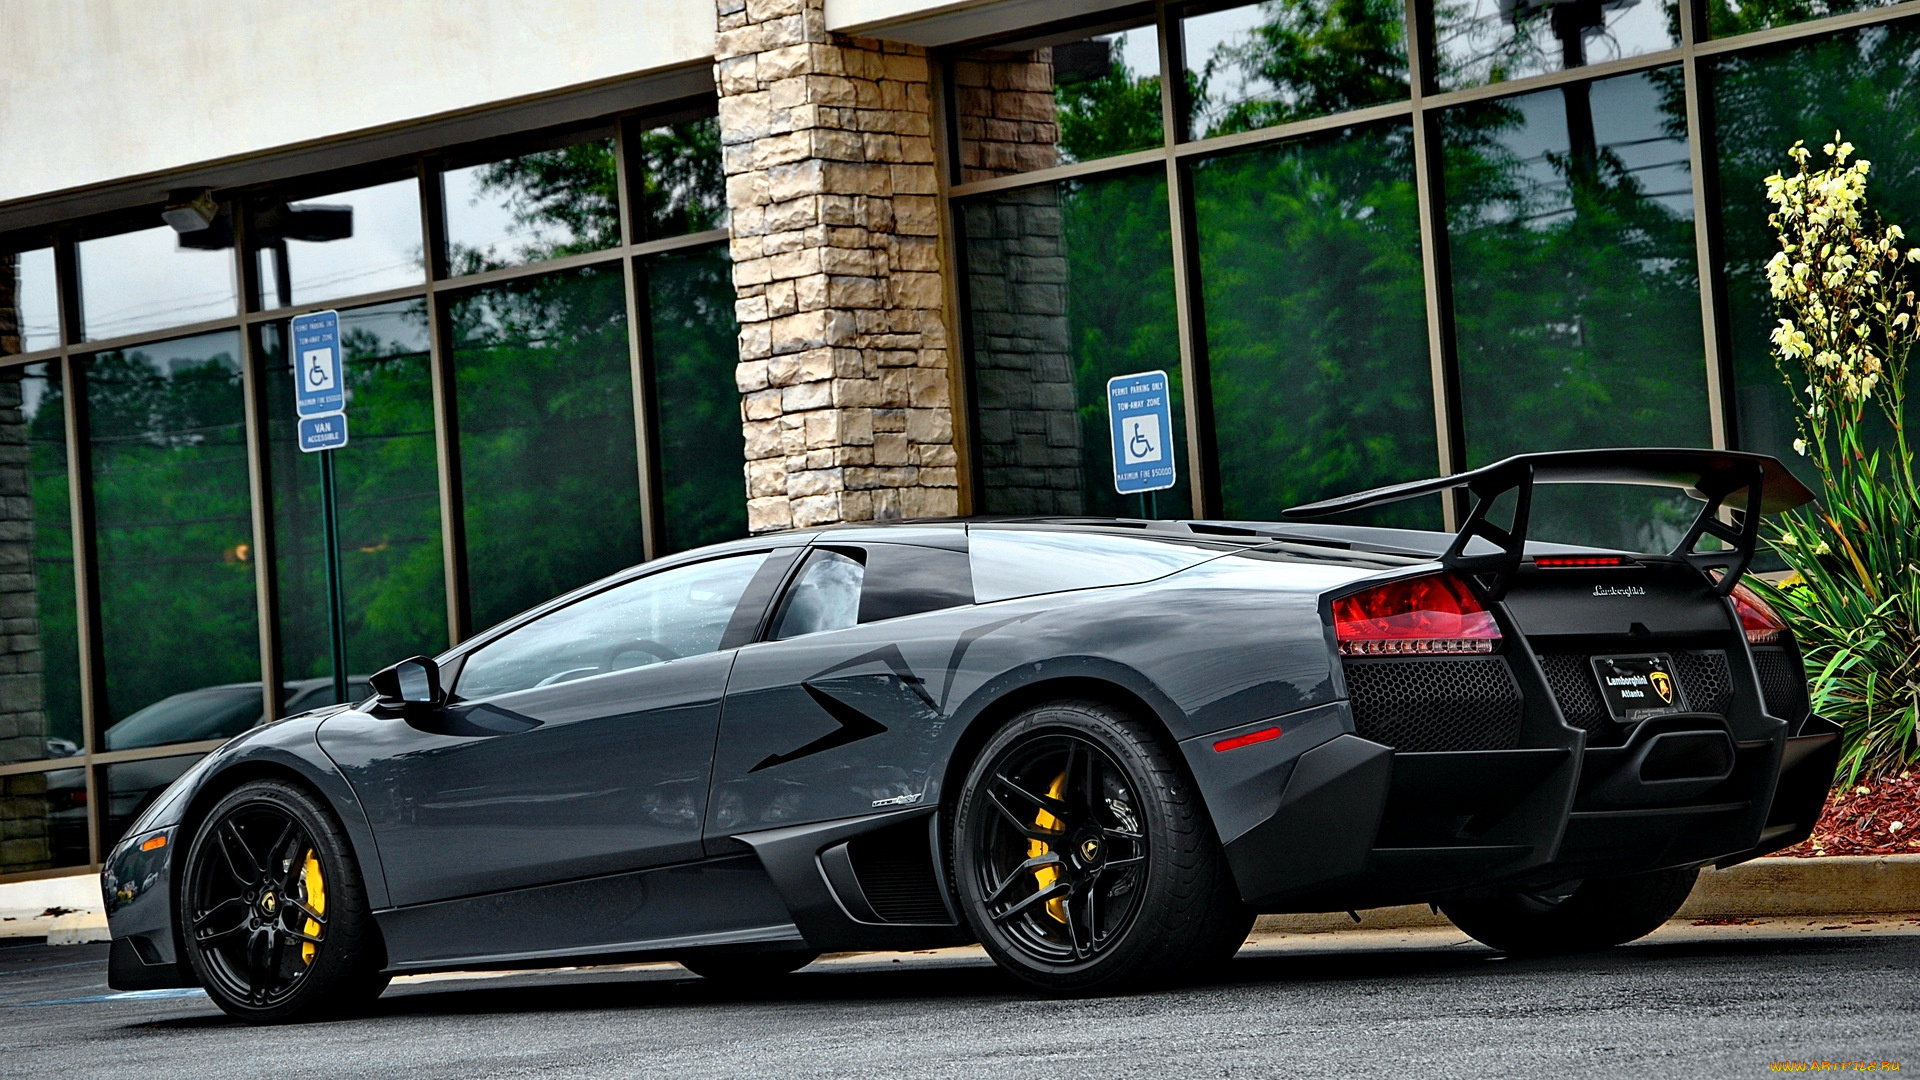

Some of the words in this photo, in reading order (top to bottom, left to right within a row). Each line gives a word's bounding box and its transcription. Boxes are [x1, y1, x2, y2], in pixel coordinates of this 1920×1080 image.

[1111, 387, 1128, 397] PERMIT
[1130, 383, 1150, 394] PARKING
[1151, 382, 1163, 391] ONLY
[1117, 400, 1144, 411] TOW-AWAY
[1146, 397, 1161, 407] ZONE
[314, 422, 331, 434] VAN
[307, 432, 340, 443] ACCESSIBLE
[1140, 469, 1150, 478] FINE
[1592, 584, 1646, 598] Lamborghini
[1605, 675, 1648, 687] Lamborghini
[1621, 689, 1645, 698] Atlanta
